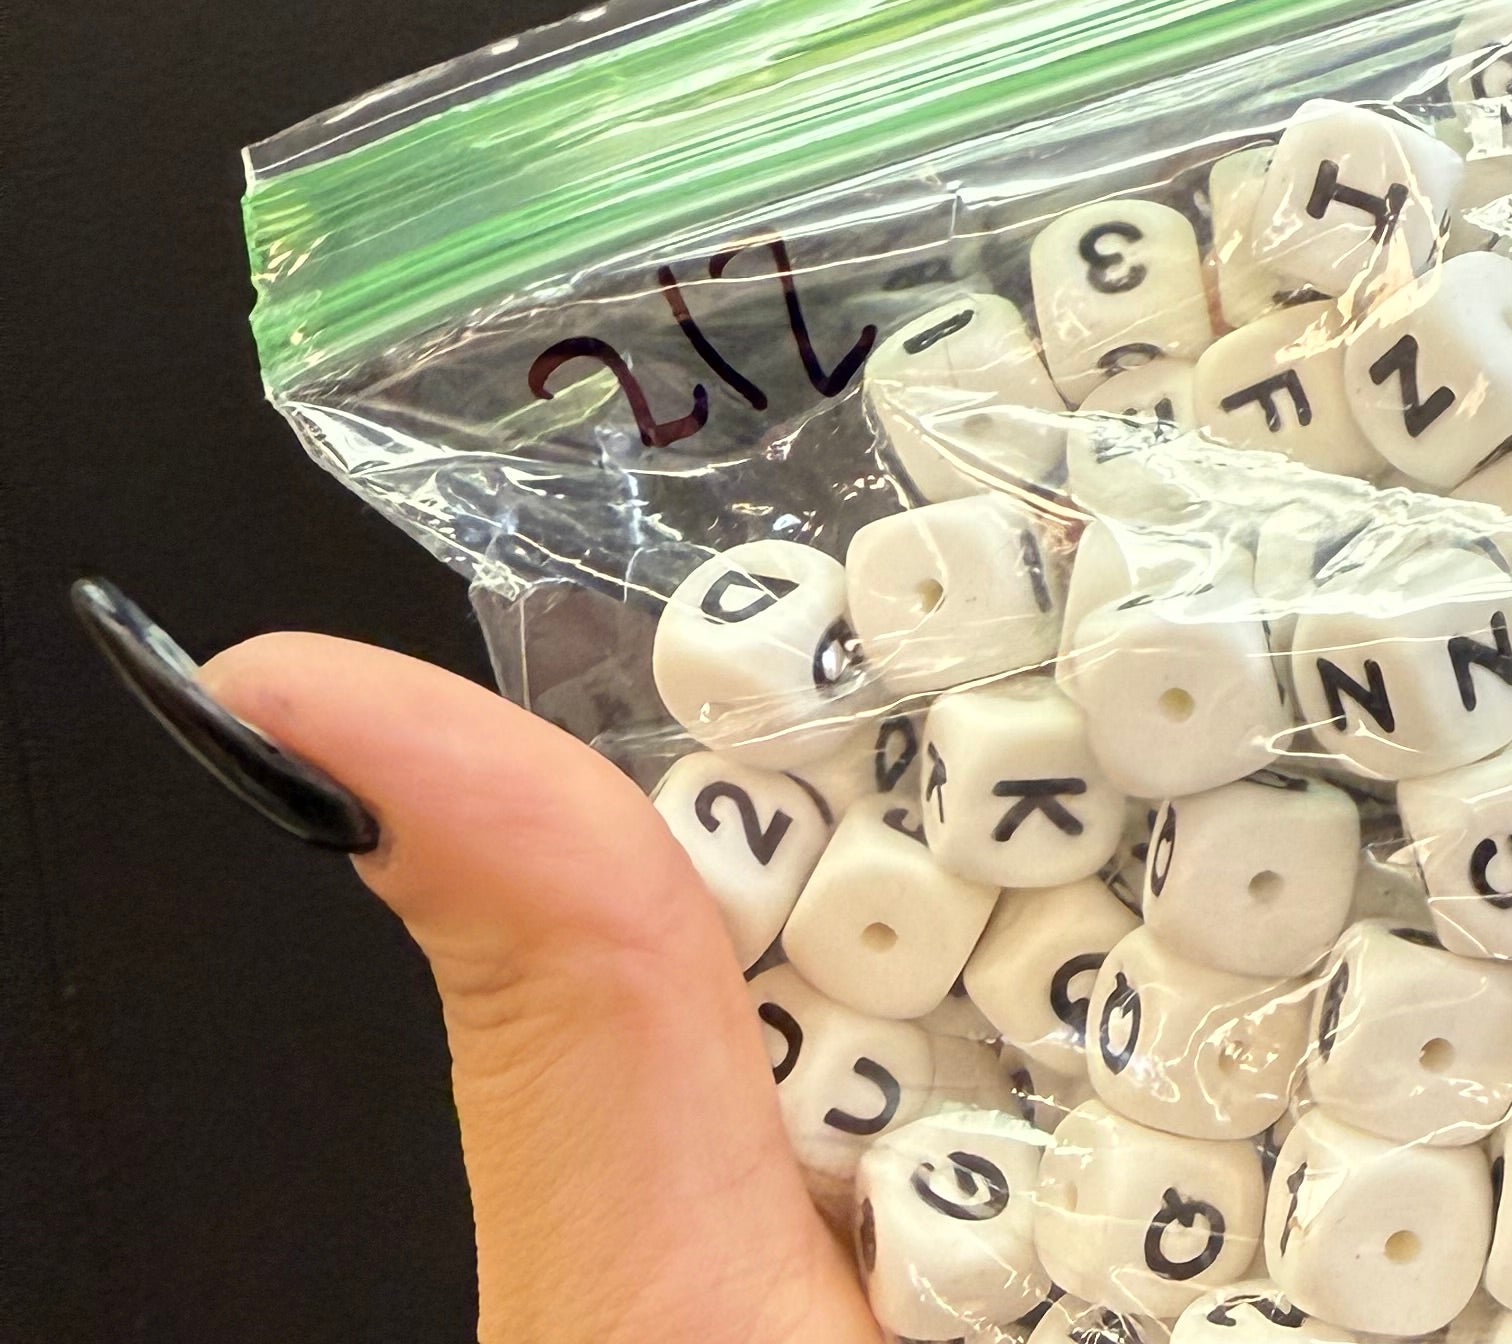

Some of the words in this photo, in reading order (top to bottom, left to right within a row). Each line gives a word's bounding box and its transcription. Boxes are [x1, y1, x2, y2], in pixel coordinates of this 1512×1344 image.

[1079, 221, 1148, 294] 3
[1221, 369, 1312, 432] F
[1369, 334, 1456, 438] Z
[1316, 657, 1395, 733] N
[694, 780, 793, 866] 2
[991, 777, 1087, 842] K
[1144, 1186, 1226, 1281] Q
